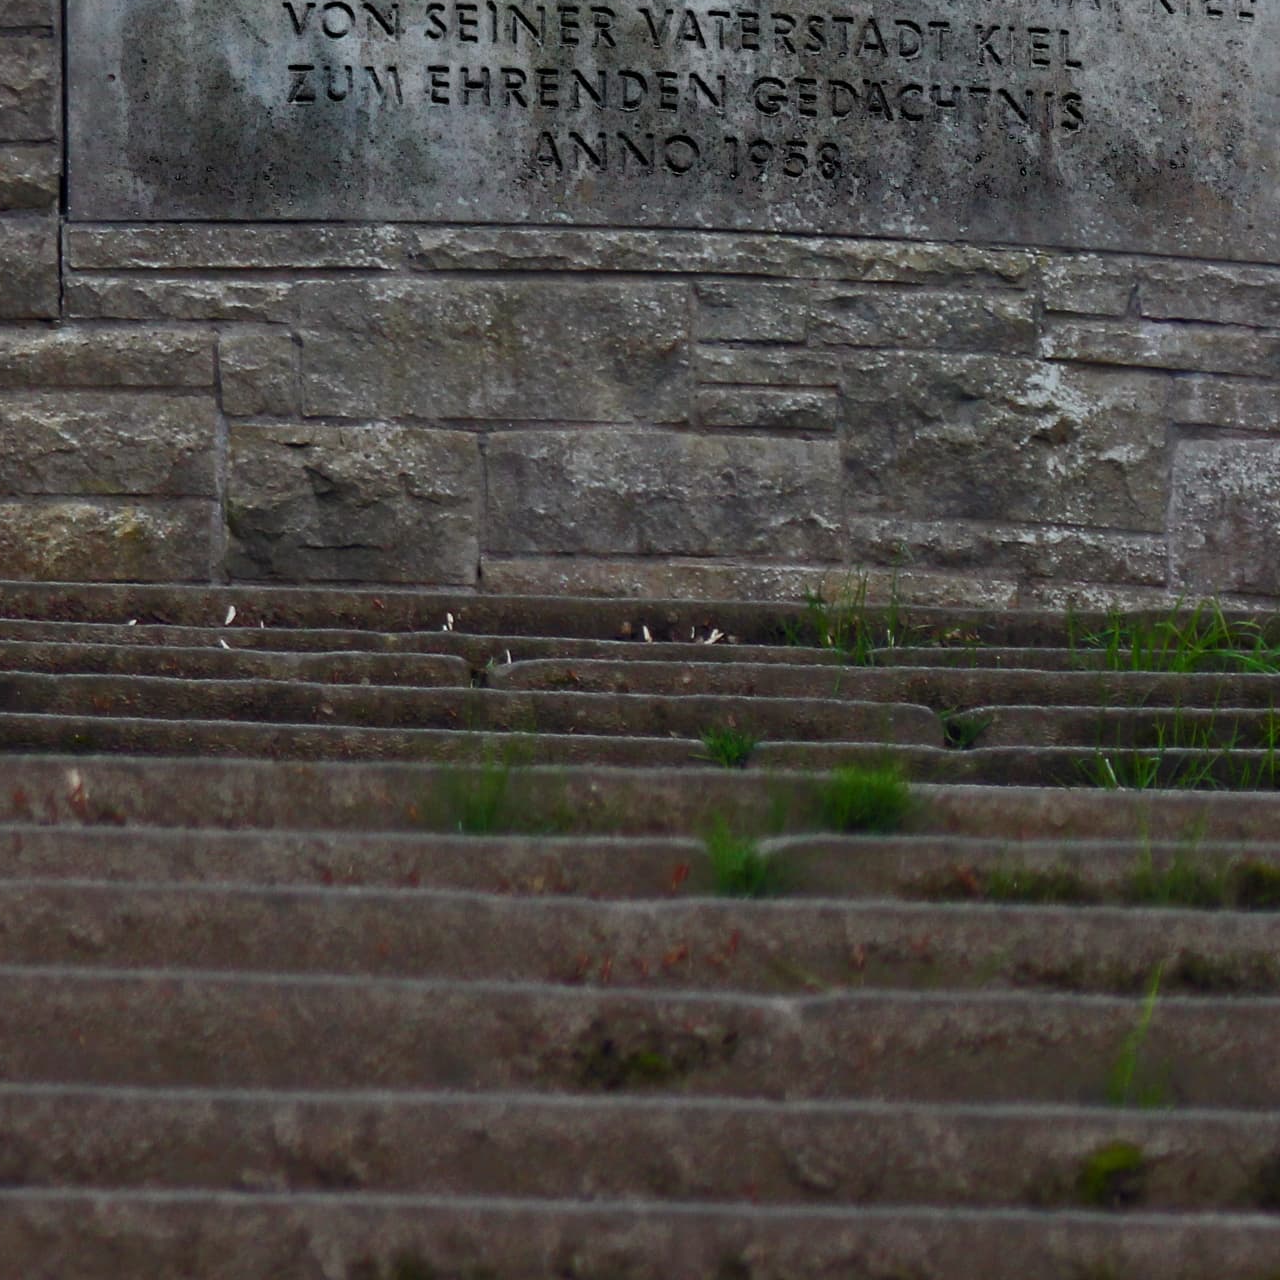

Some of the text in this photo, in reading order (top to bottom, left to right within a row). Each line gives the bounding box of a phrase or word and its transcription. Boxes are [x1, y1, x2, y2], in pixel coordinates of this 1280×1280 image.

[283, 0, 1082, 70] VON SEINER VATERSTADT KIEL
[286, 64, 1084, 132] ZUM EHRENDEN GEDÄCHTNIS
[537, 131, 843, 181] ANNO 1958
